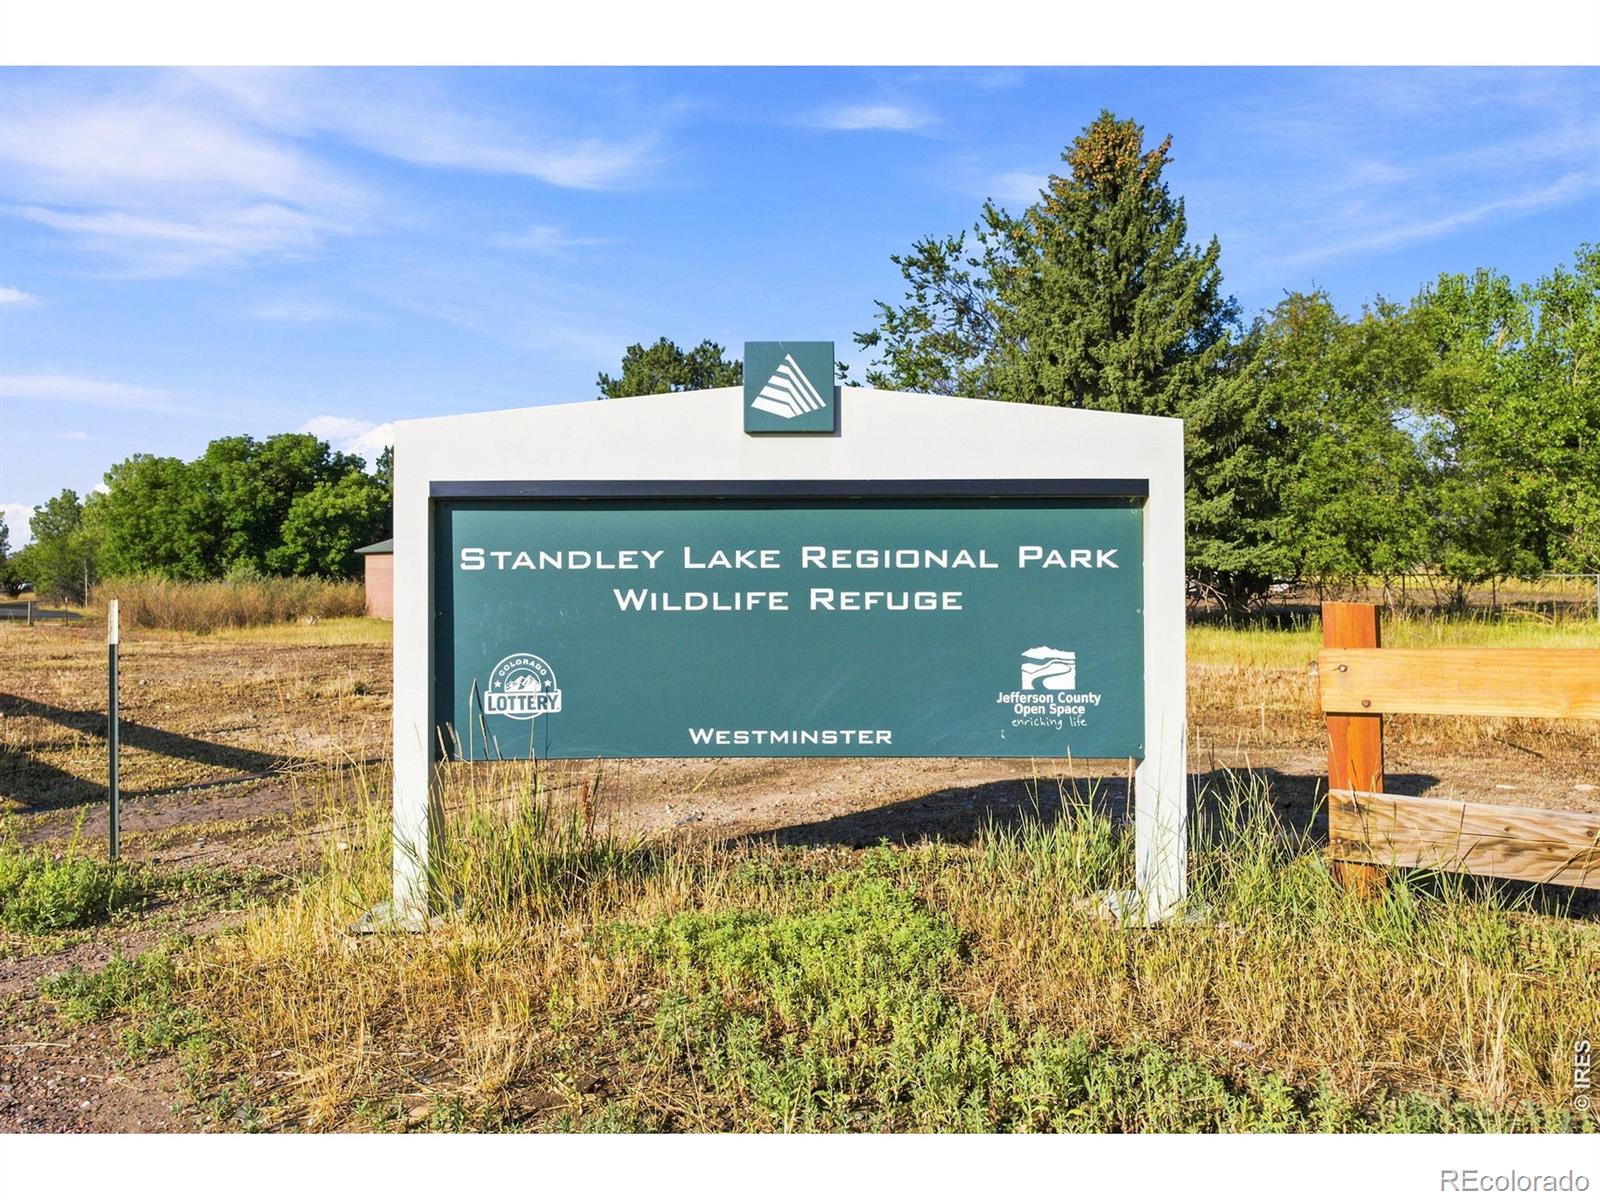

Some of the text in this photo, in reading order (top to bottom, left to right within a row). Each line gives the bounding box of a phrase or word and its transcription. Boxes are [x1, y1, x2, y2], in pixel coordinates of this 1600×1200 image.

[683, 547, 780, 570] LAKE
[1018, 546, 1119, 570] PARK
[809, 588, 963, 611] REFUGE
[498, 658, 547, 677] COLORADO
[487, 694, 558, 712] LOTTERY
[996, 691, 1101, 706] Jefferson County
[1014, 703, 1086, 717] Open Space
[1011, 714, 1088, 730] enriching life
